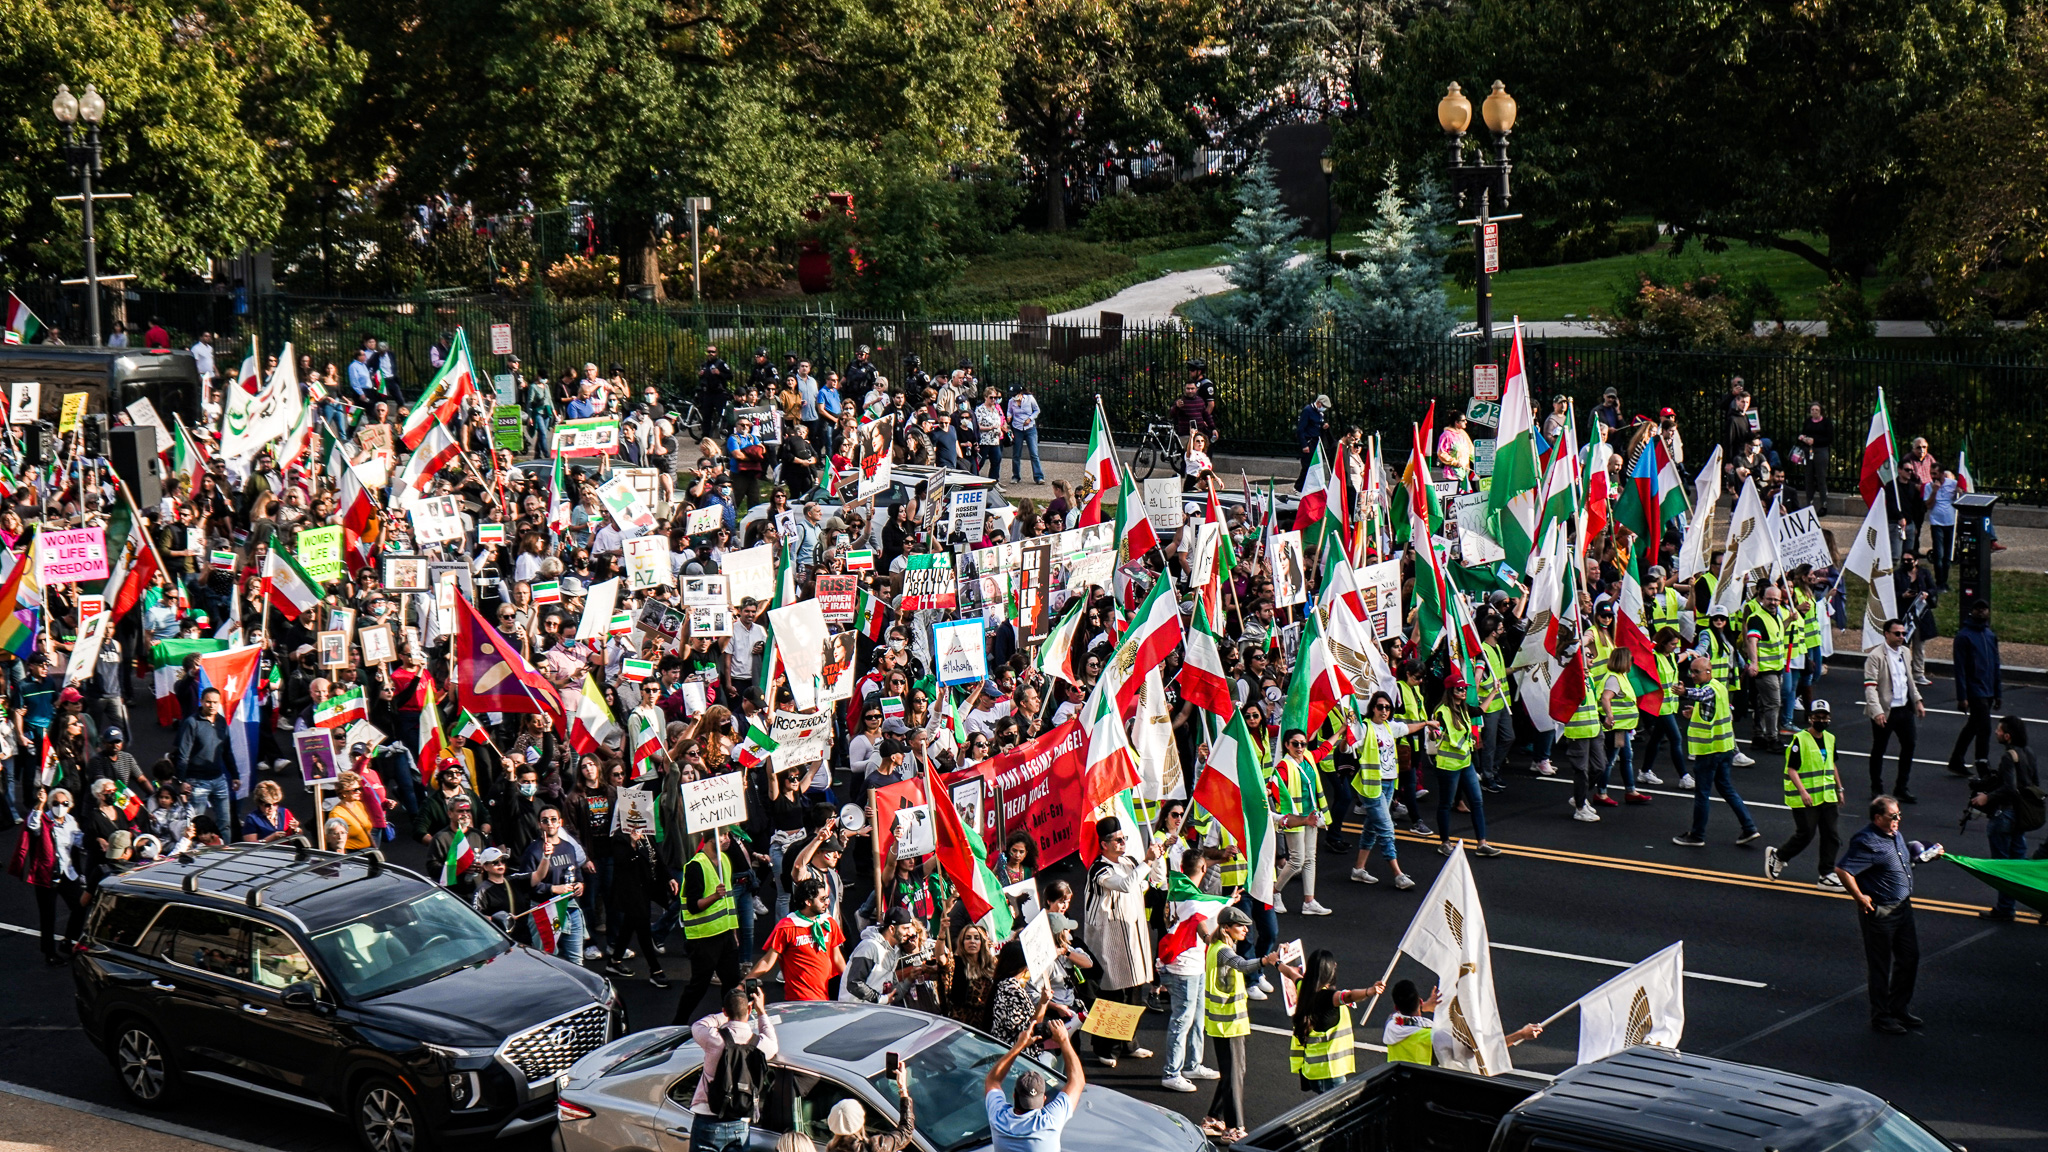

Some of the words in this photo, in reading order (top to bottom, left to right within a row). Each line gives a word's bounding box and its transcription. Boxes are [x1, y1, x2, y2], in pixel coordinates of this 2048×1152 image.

[1492, 406, 1500, 416] 2
[956, 492, 982, 504] FREE
[692, 518, 718, 534] IRAN
[44, 533, 94, 546] WOMEN
[304, 533, 334, 547] WOMEN
[59, 548, 86, 558] LIFE
[310, 548, 328, 560] LIFE
[932, 552, 949, 568] 23
[44, 560, 104, 576] FREEDOM
[306, 562, 339, 576] REEDOM
[905, 567, 950, 583] ACCOUNT
[820, 579, 854, 592] RISE
[906, 580, 950, 596] ABILITY
[918, 594, 937, 610] 144
[694, 776, 729, 791] #IRAN
[690, 790, 738, 812] #MAHSA
[700, 805, 736, 825] AMINI
[1032, 802, 1064, 828] Anti-Gay
[1040, 836, 1051, 850] Go
[1052, 821, 1073, 845] Away!
